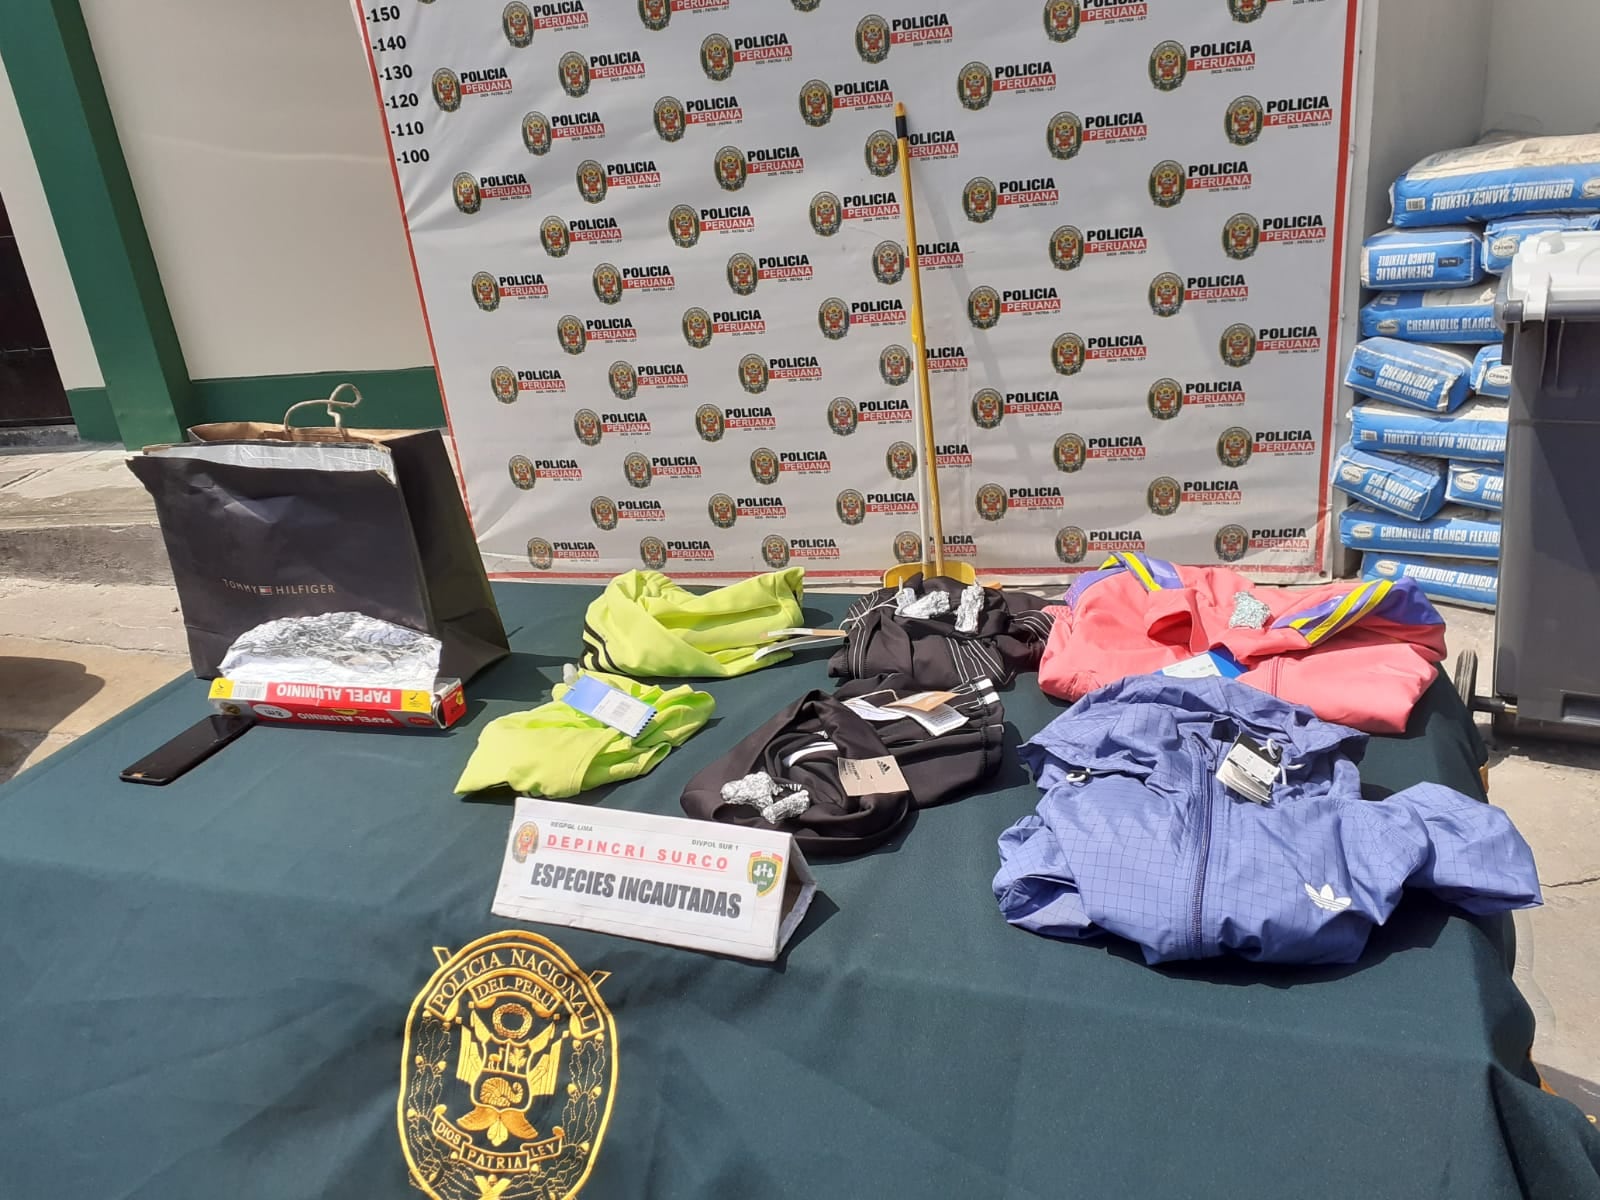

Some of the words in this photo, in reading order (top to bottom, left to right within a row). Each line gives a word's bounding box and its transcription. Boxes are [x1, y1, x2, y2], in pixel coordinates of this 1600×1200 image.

[534, 0, 584, 17] POLICIA
[1087, 5, 1146, 21] PERUANA
[540, 14, 586, 28] PERUANA
[892, 14, 948, 31] POLICIA
[735, 33, 788, 50] POLICIA
[896, 28, 951, 43] PERUANA
[739, 47, 790, 61] PERUANA
[1190, 40, 1252, 58] POLICIA
[590, 52, 640, 67] POLICIA
[1194, 55, 1254, 70] PERUANA
[461, 68, 507, 83] POLICIA
[596, 65, 643, 78] PERUANA
[995, 62, 1052, 78] POLICIA
[466, 81, 510, 94] PERUANA
[835, 80, 889, 96] POLICIA
[1000, 76, 1054, 90] PERUANA
[686, 96, 738, 112] POLICIA
[840, 93, 891, 107] PERUANA
[1267, 96, 1329, 113] POLICIA
[552, 112, 600, 127] POLICIA
[692, 110, 741, 123] PERUANA
[1086, 112, 1143, 128] POLICIA
[1271, 110, 1331, 125] PERUANA
[557, 125, 603, 137] PERUANA
[1089, 127, 1145, 140] PERUANA
[748, 147, 800, 162] POLICIA
[607, 161, 656, 175] POLICIA
[752, 160, 802, 173] PERUANA
[1189, 161, 1248, 177] POLICIA
[480, 174, 527, 187] POLICIA
[612, 174, 658, 186] PERUANA
[1000, 178, 1055, 193] POLICIA
[1193, 175, 1250, 188] PERUANA
[486, 186, 530, 197] PERUANA
[1005, 191, 1057, 204] PERUANA
[1512, 183, 1574, 203] CHEMAYOLIC
[844, 192, 896, 207] POLICIA
[701, 206, 750, 220] POLICIA
[848, 206, 898, 218] PERUANA
[570, 218, 617, 231] POLICIA
[706, 219, 752, 230] PERUANA
[1263, 215, 1322, 230] POLICIA
[575, 230, 620, 241] PERUANA
[1087, 227, 1143, 241] POLICIA
[1267, 229, 1325, 241] PERUANA
[907, 242, 960, 256] OLICIA
[1091, 240, 1145, 253] PERUANA
[759, 255, 809, 268] POLICIA
[918, 255, 962, 266] ERUANA
[623, 266, 670, 278] POLICIA
[764, 267, 811, 278] PERUANA
[1376, 265, 1434, 281] CHEMAYOLIC
[500, 274, 544, 286] POLICIA
[1188, 275, 1245, 288] POLICIA
[1003, 288, 1057, 301] POLICIA
[1191, 288, 1247, 299] PERUANA
[852, 300, 902, 313] POLICIA
[1008, 301, 1059, 312] PERUANA
[714, 310, 761, 322] POLICIA
[856, 312, 905, 323] PERUANA
[586, 318, 632, 330] POLICIA
[1406, 319, 1459, 331] CHEMAYOLIC
[1260, 326, 1317, 339] POLICIA
[1088, 335, 1143, 348] POLICIA
[1263, 339, 1319, 350] PERUANA
[1093, 348, 1145, 359] PERUANA
[770, 357, 818, 368] POLICIA
[638, 364, 684, 375] POLICIA
[1379, 364, 1438, 391] CHEMAYOLIC
[1186, 381, 1242, 393] POLICIA
[1006, 391, 1059, 403] POLICIA
[1191, 394, 1243, 403] PERUANA
[860, 400, 908, 411] POLICIA
[1010, 403, 1061, 413] PERUANA
[602, 413, 647, 423] POLICIA
[726, 408, 772, 418] POLICIA
[864, 411, 911, 421] PERUANA
[1089, 436, 1142, 448] POLICIA
[1256, 430, 1312, 442] POLICIA
[1092, 449, 1144, 457] PERUANA
[1259, 443, 1313, 451] PERUANA
[652, 456, 697, 466] POLICIA
[780, 452, 827, 462] POLICIA
[1010, 487, 1060, 498] POLICIA
[1184, 481, 1238, 491] POLICIA
[738, 498, 782, 507] POLICIA
[868, 493, 915, 503] POLICIA
[1013, 498, 1062, 507] PERUANA
[1187, 493, 1239, 501] PERUANA
[618, 501, 661, 509] POLICIA
[1090, 532, 1142, 540] POLICIA
[1252, 528, 1306, 538] POLICIA
[1380, 526, 1432, 540] CHEMAYOLIC
[1433, 528, 1466, 542] BLANCO
[667, 541, 710, 549] POLICIA
[791, 540, 836, 548] POLICIA
[1403, 564, 1457, 583] CHEMAYOLIC
[1457, 572, 1494, 587] BLANCO
[222, 578, 258, 594] TOMMY
[275, 584, 336, 595] HILFIGER
[276, 684, 342, 702] ALUMINIO
[346, 688, 392, 704] PAPEL
[355, 715, 394, 724] PAPEL
[692, 839, 716, 849] DIVPOL
[719, 842, 733, 850] SUR
[547, 834, 644, 858] DEPINCRI
[657, 848, 728, 870] SURCO
[531, 862, 615, 898] ESPECIES
[617, 875, 742, 919] INCAUTADAS
[432, 952, 505, 1012] POLICIA
[510, 948, 598, 1029] NACIONAL
[477, 978, 509, 998] DEL
[513, 978, 556, 1009] PERU
[530, 1143, 555, 1158] LEY
[467, 1149, 522, 1169] PATRIA
